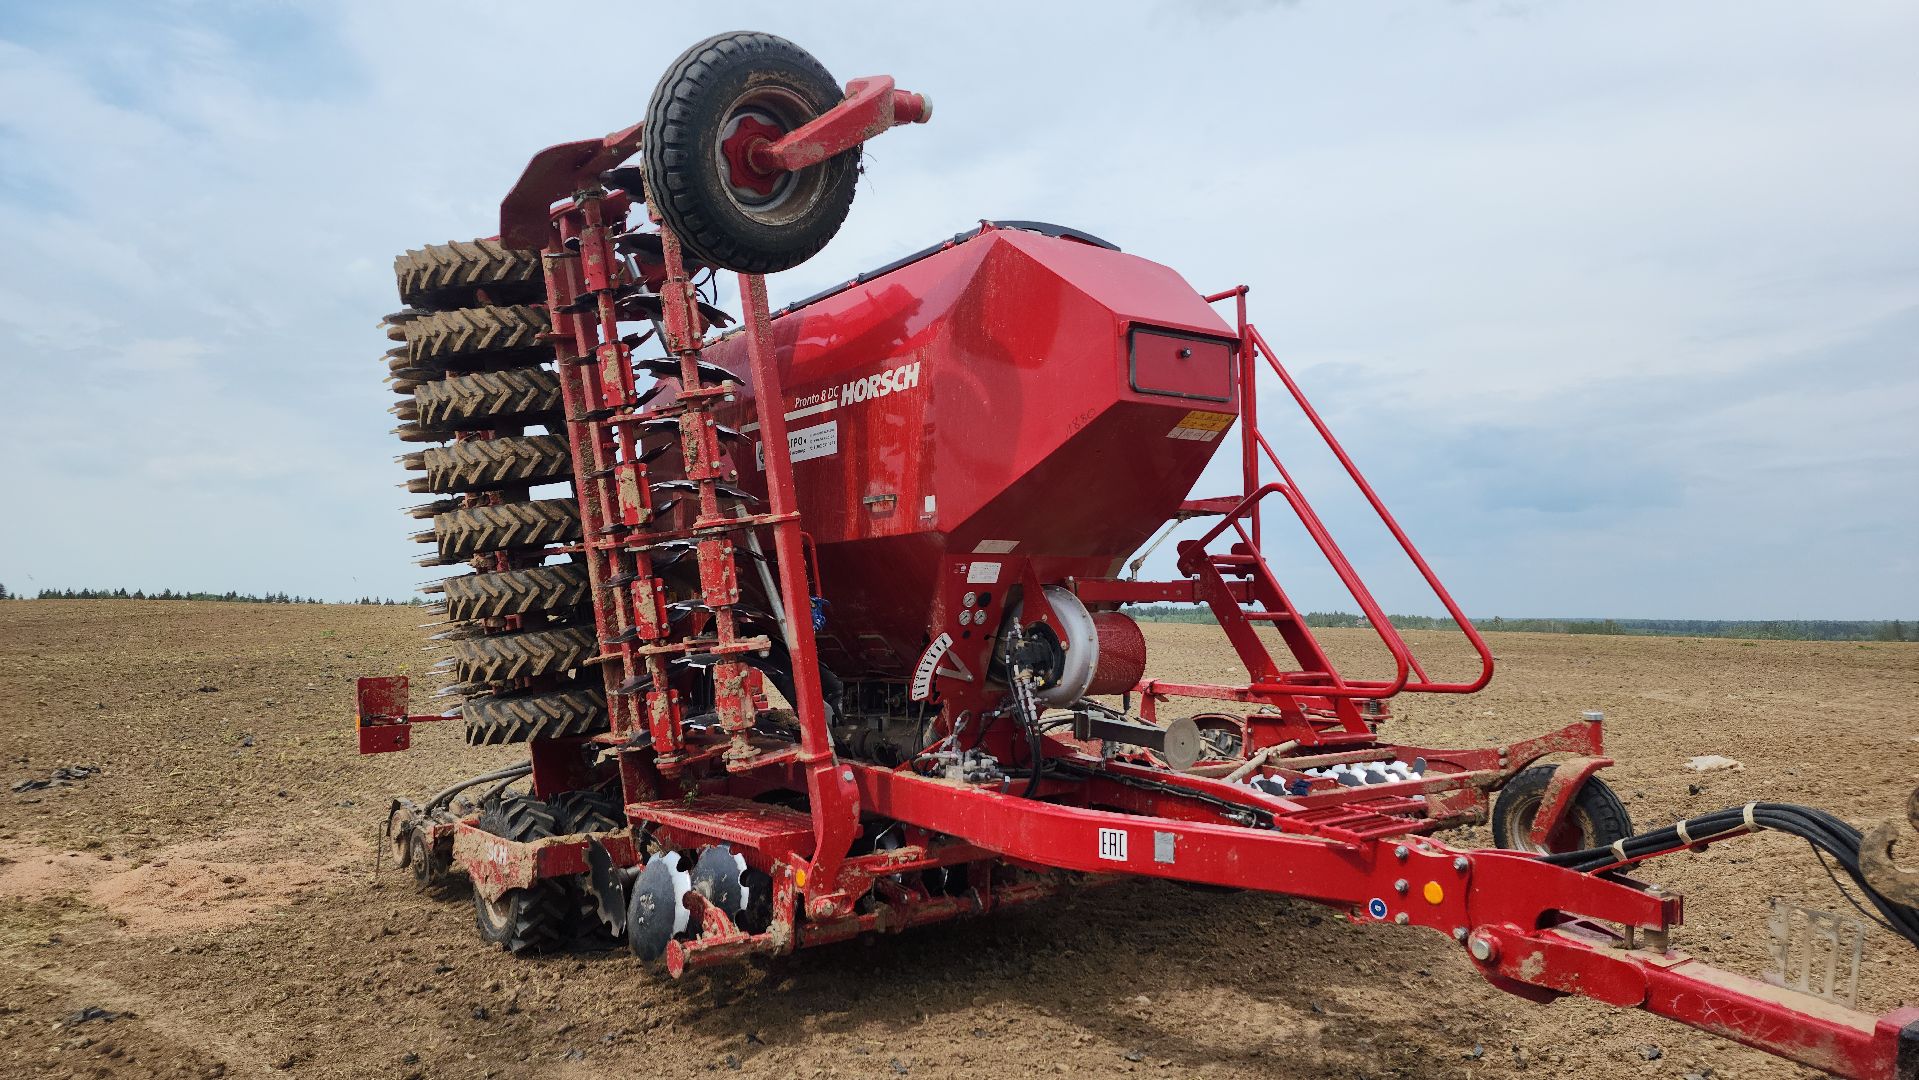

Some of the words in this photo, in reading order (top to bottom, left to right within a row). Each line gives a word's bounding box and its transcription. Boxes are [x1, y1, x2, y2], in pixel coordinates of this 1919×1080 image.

[795, 394, 820, 408] Pronto
[821, 389, 826, 402] 8
[828, 385, 839, 398] DC
[841, 361, 920, 407] HORSCH
[1102, 831, 1124, 858] EAC
